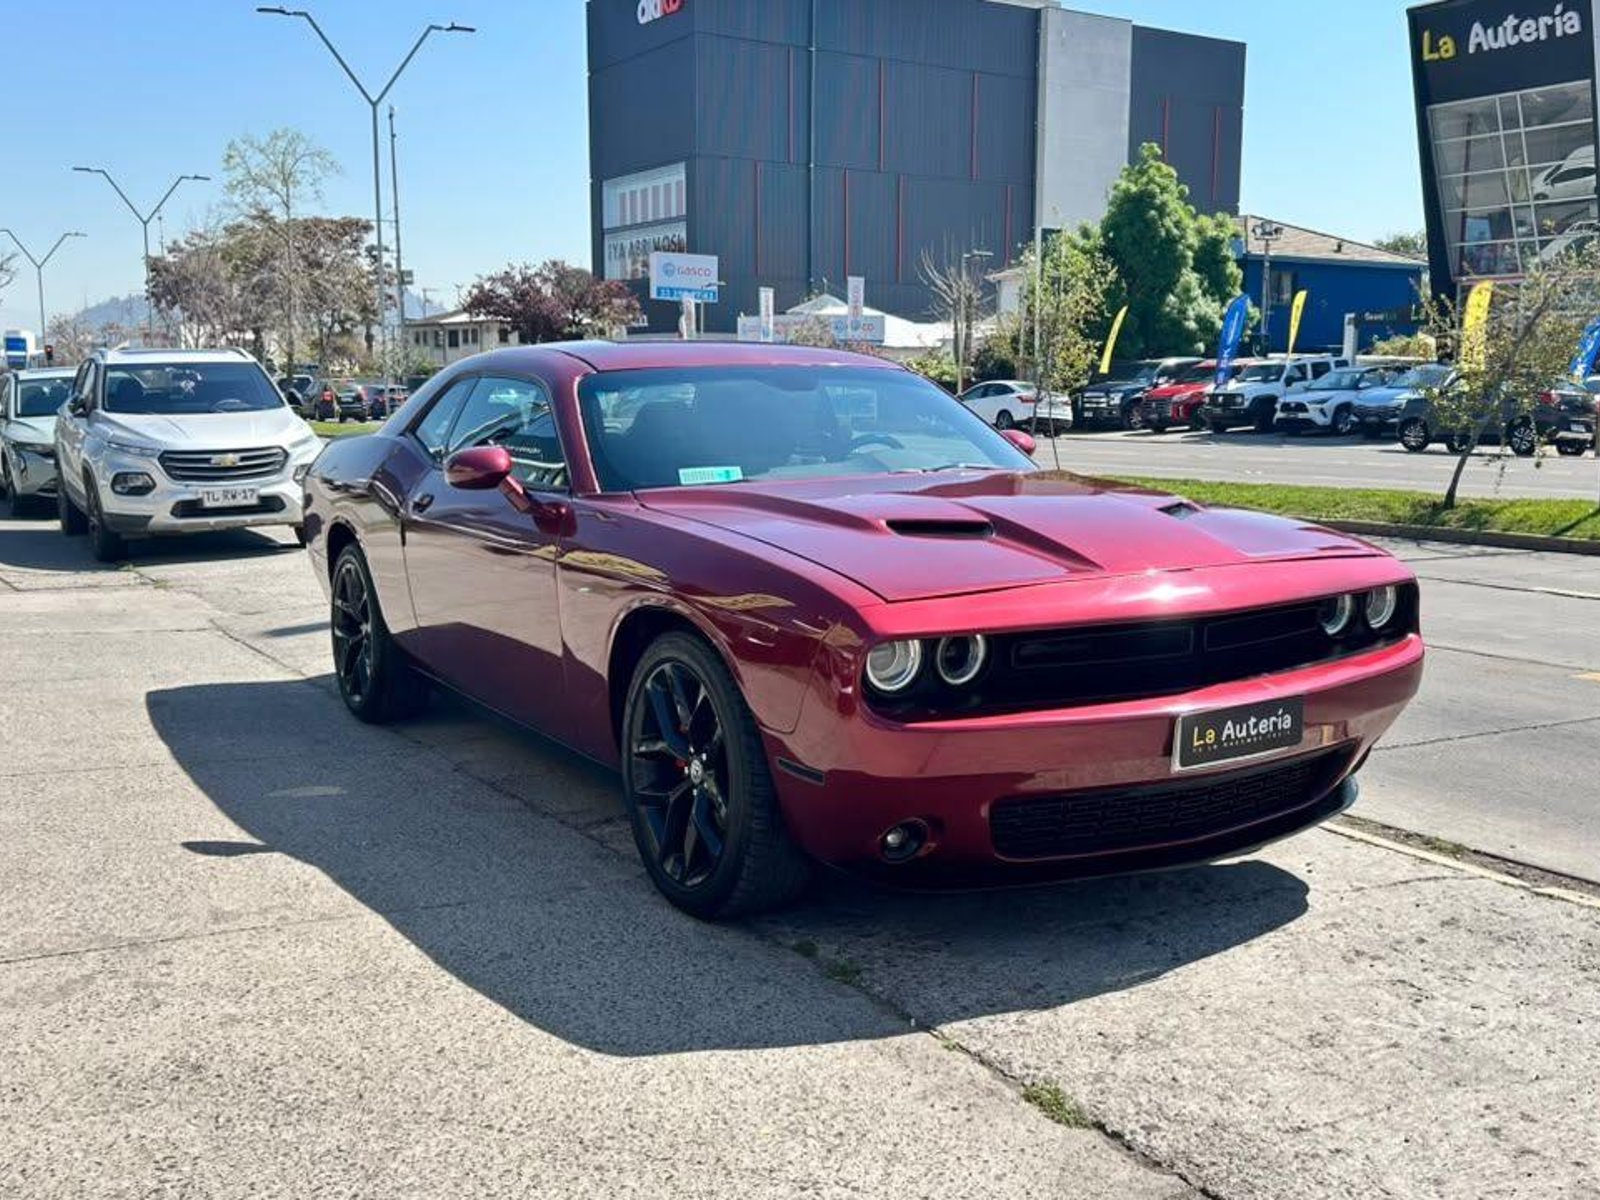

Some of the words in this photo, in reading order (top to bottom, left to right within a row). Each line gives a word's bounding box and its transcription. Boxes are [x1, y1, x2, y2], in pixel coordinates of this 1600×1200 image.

[1422, 30, 1456, 61] La
[1468, 3, 1582, 54] Autería
[1192, 725, 1216, 747] La
[1221, 708, 1292, 742] Autería
